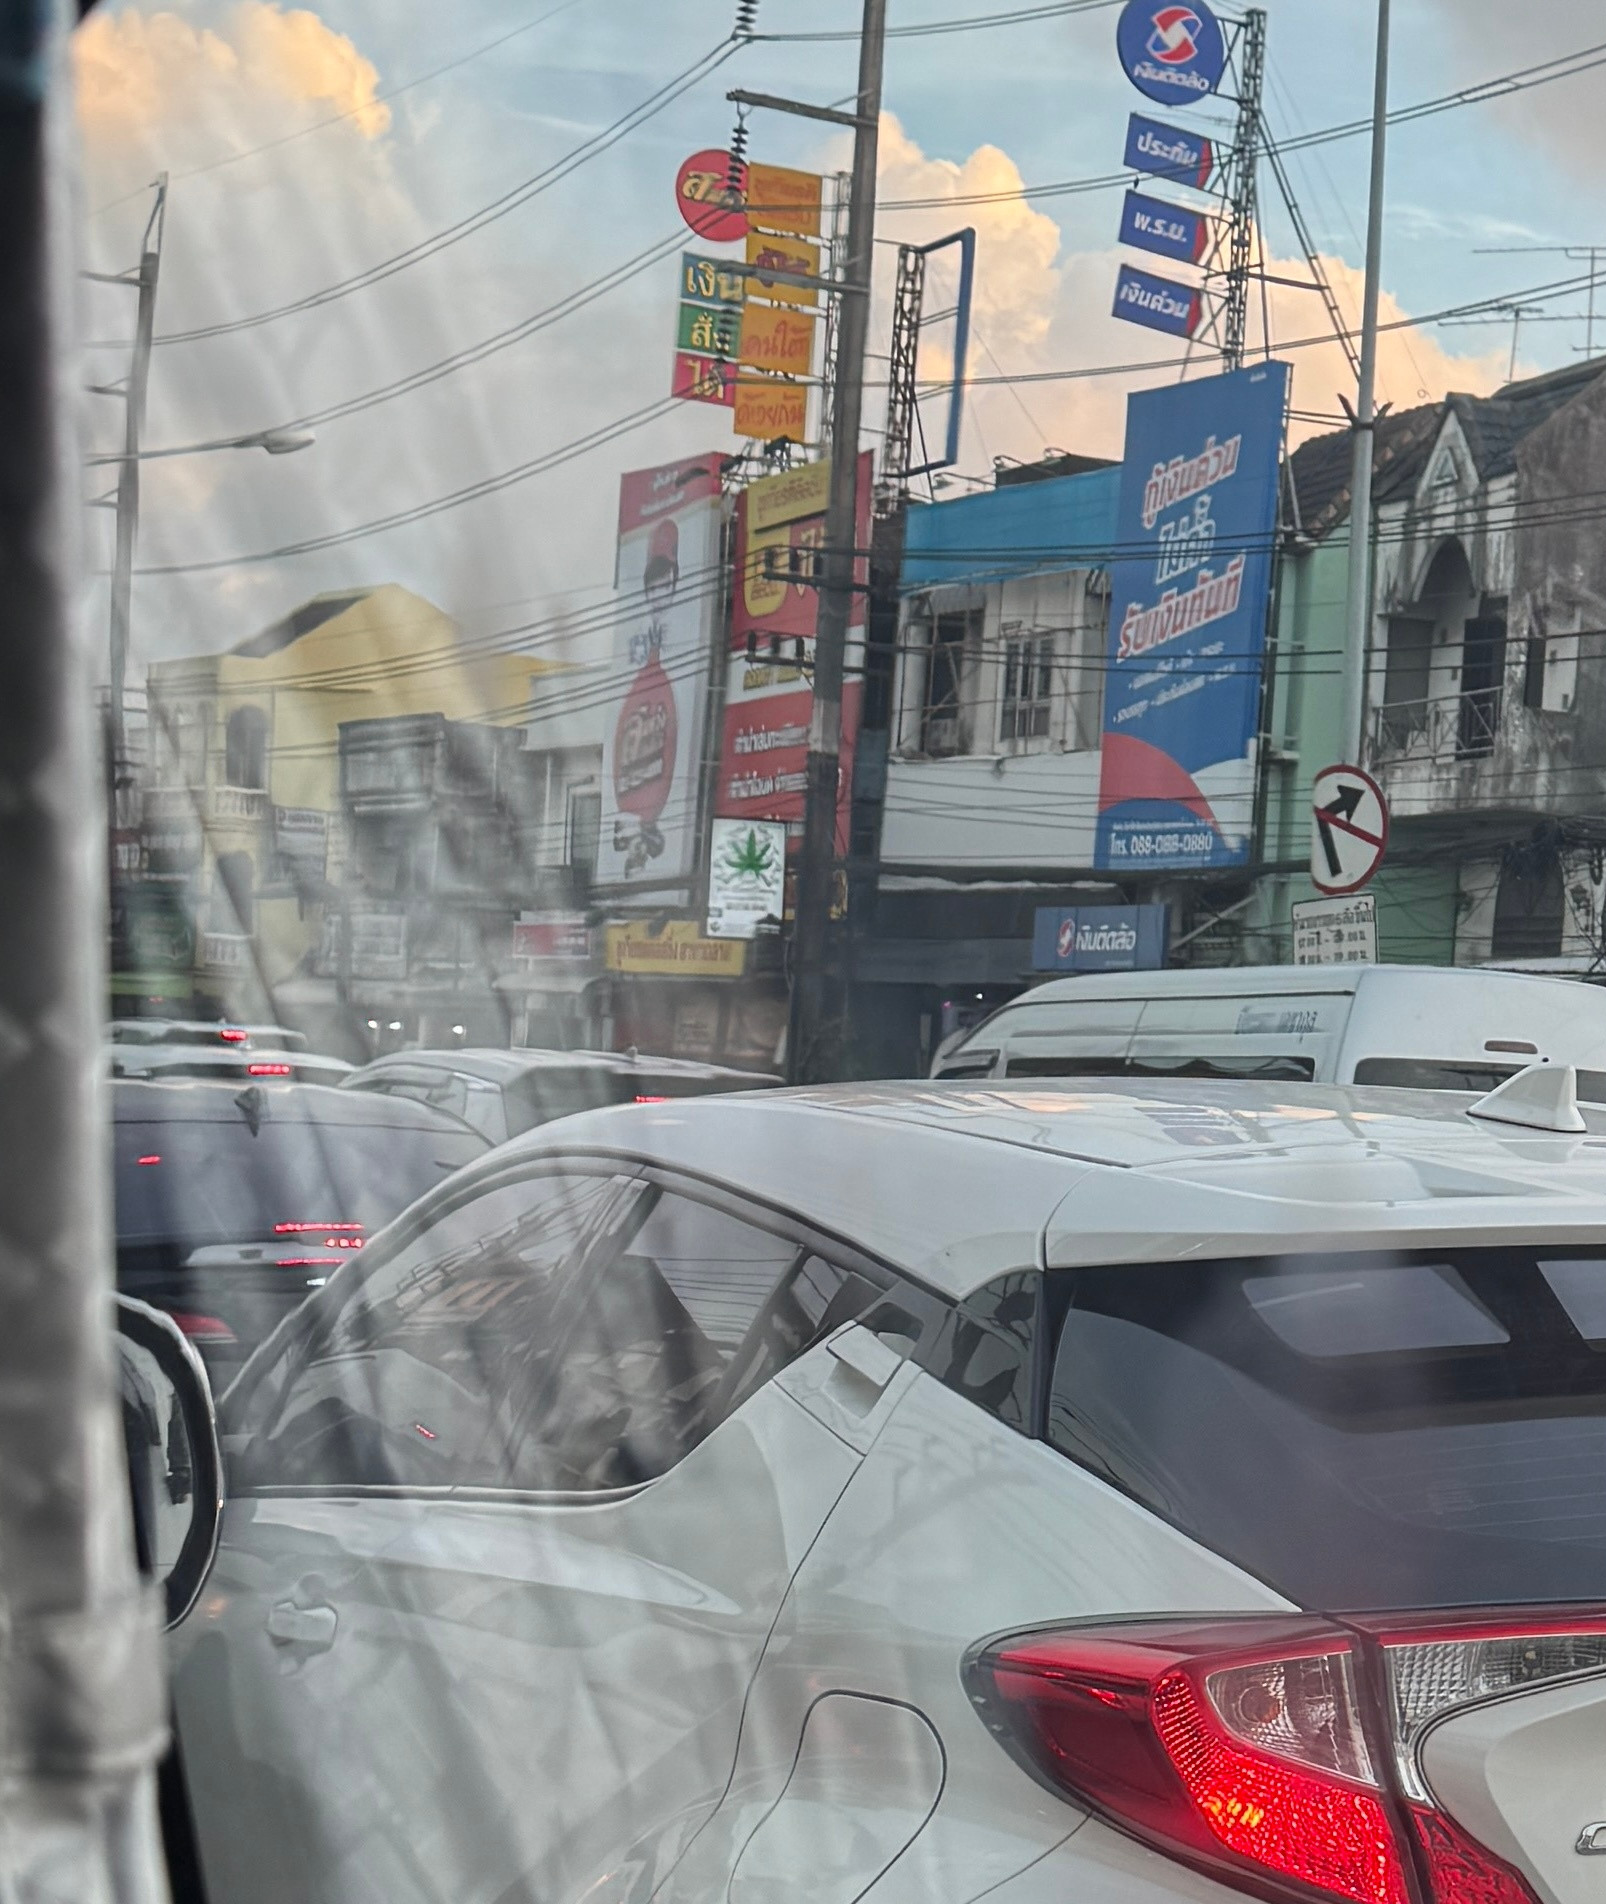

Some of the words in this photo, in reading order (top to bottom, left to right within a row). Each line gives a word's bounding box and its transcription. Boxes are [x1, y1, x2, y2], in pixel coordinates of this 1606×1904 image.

[1136, 131, 1199, 168] ประกัน
[1133, 211, 1188, 243] พ.ร.บ.
[686, 260, 744, 301] เงิน
[1119, 281, 1191, 319] เงินด่วน
[1142, 434, 1242, 530] กู้เงินด่วน
[1116, 549, 1247, 664] รับเงินทันที
